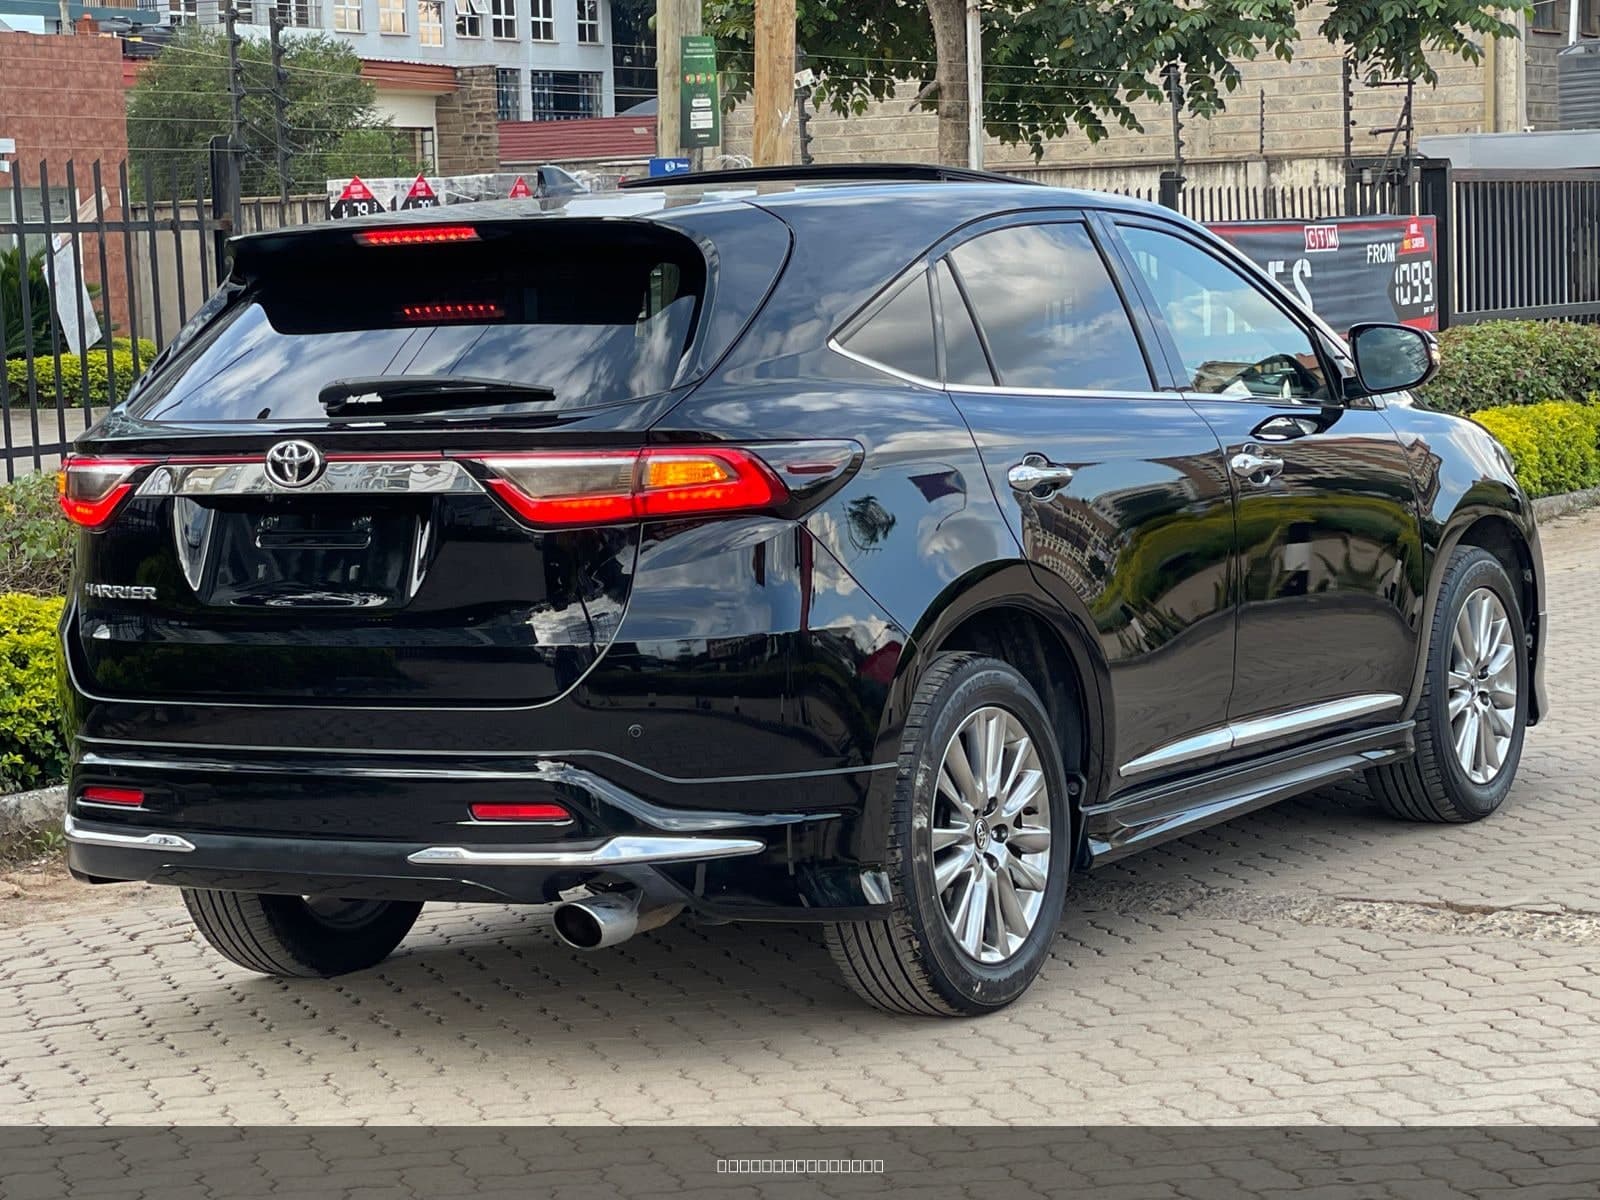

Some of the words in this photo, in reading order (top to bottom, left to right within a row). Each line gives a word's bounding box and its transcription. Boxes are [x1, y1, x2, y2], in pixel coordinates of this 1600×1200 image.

[1307, 227, 1338, 249] CTM
[1366, 243, 1396, 264] FROM
[1395, 261, 1433, 305] 1099
[85, 582, 157, 600] HARRIER
